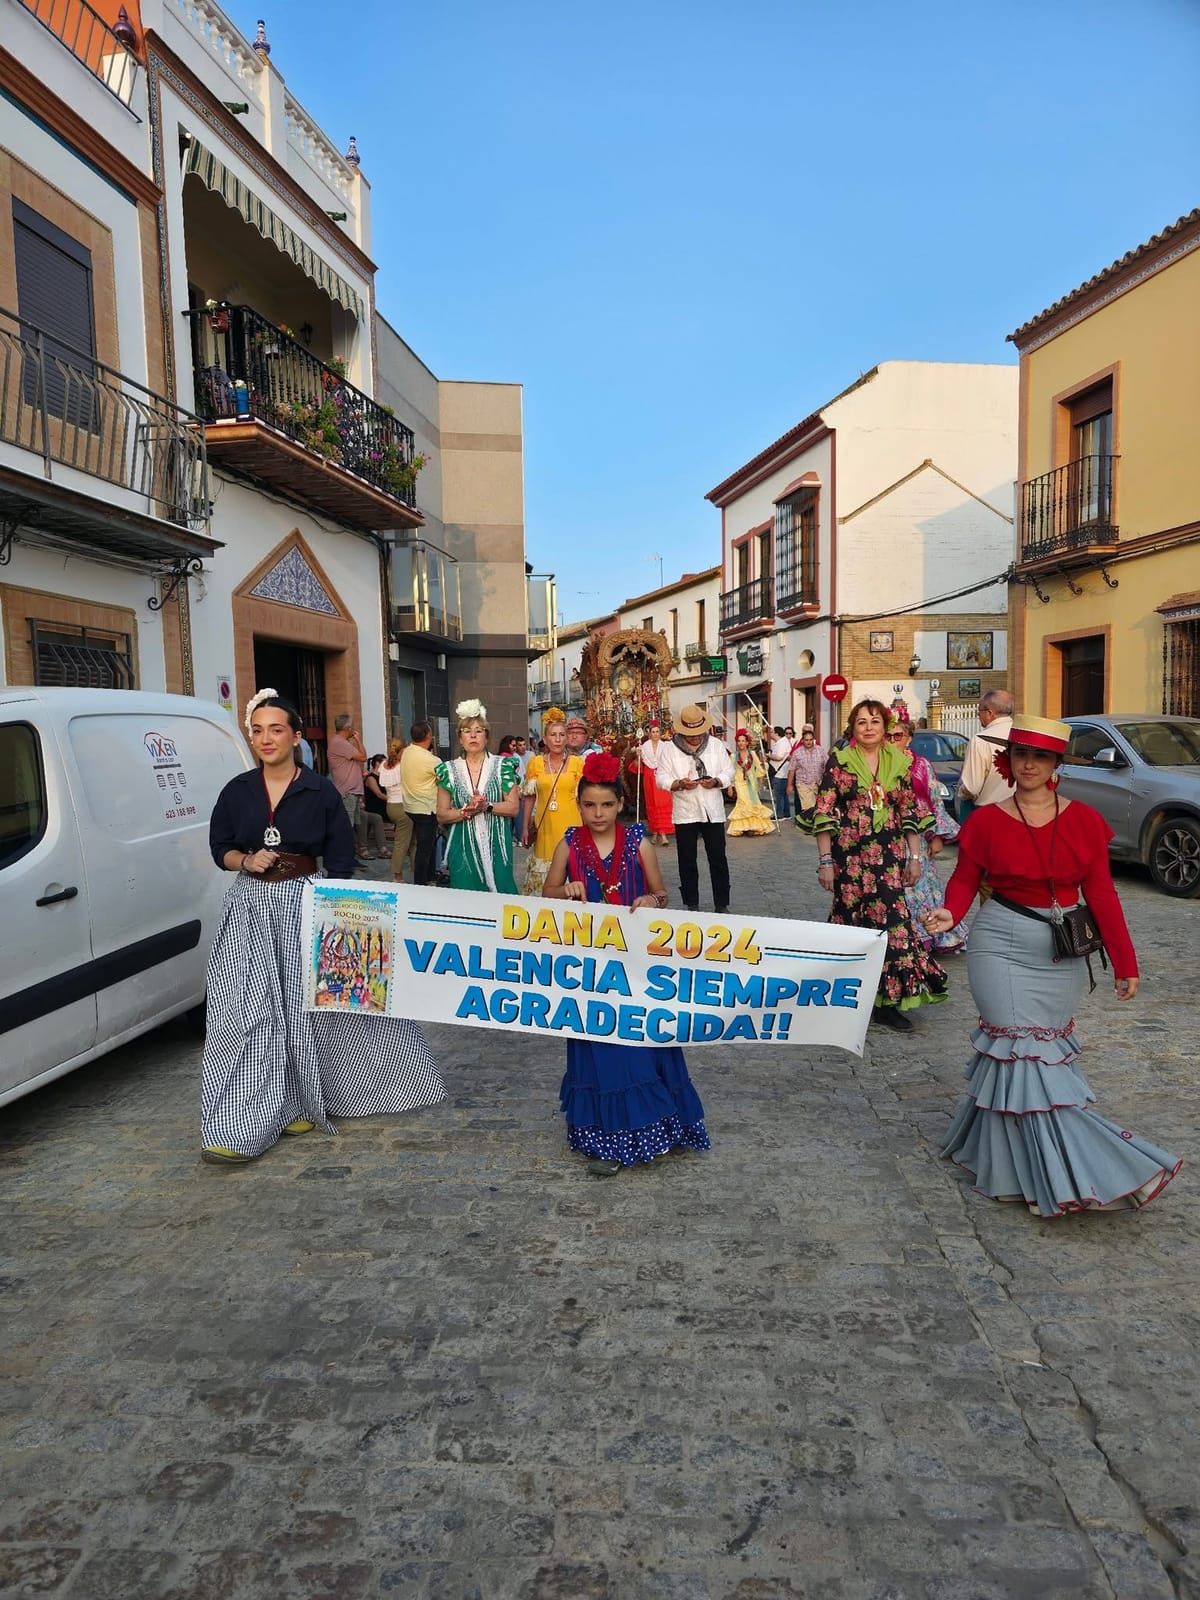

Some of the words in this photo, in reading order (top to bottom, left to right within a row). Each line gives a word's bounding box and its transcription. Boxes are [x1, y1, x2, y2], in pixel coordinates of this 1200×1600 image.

[146, 739, 178, 758] VIXEN
[501, 905, 627, 953] DANA
[647, 921, 762, 966] 2024
[404, 939, 632, 998] VALENCIA
[645, 965, 862, 1010] SIEMPRE
[455, 985, 793, 1044] AGRADECIDA!!
